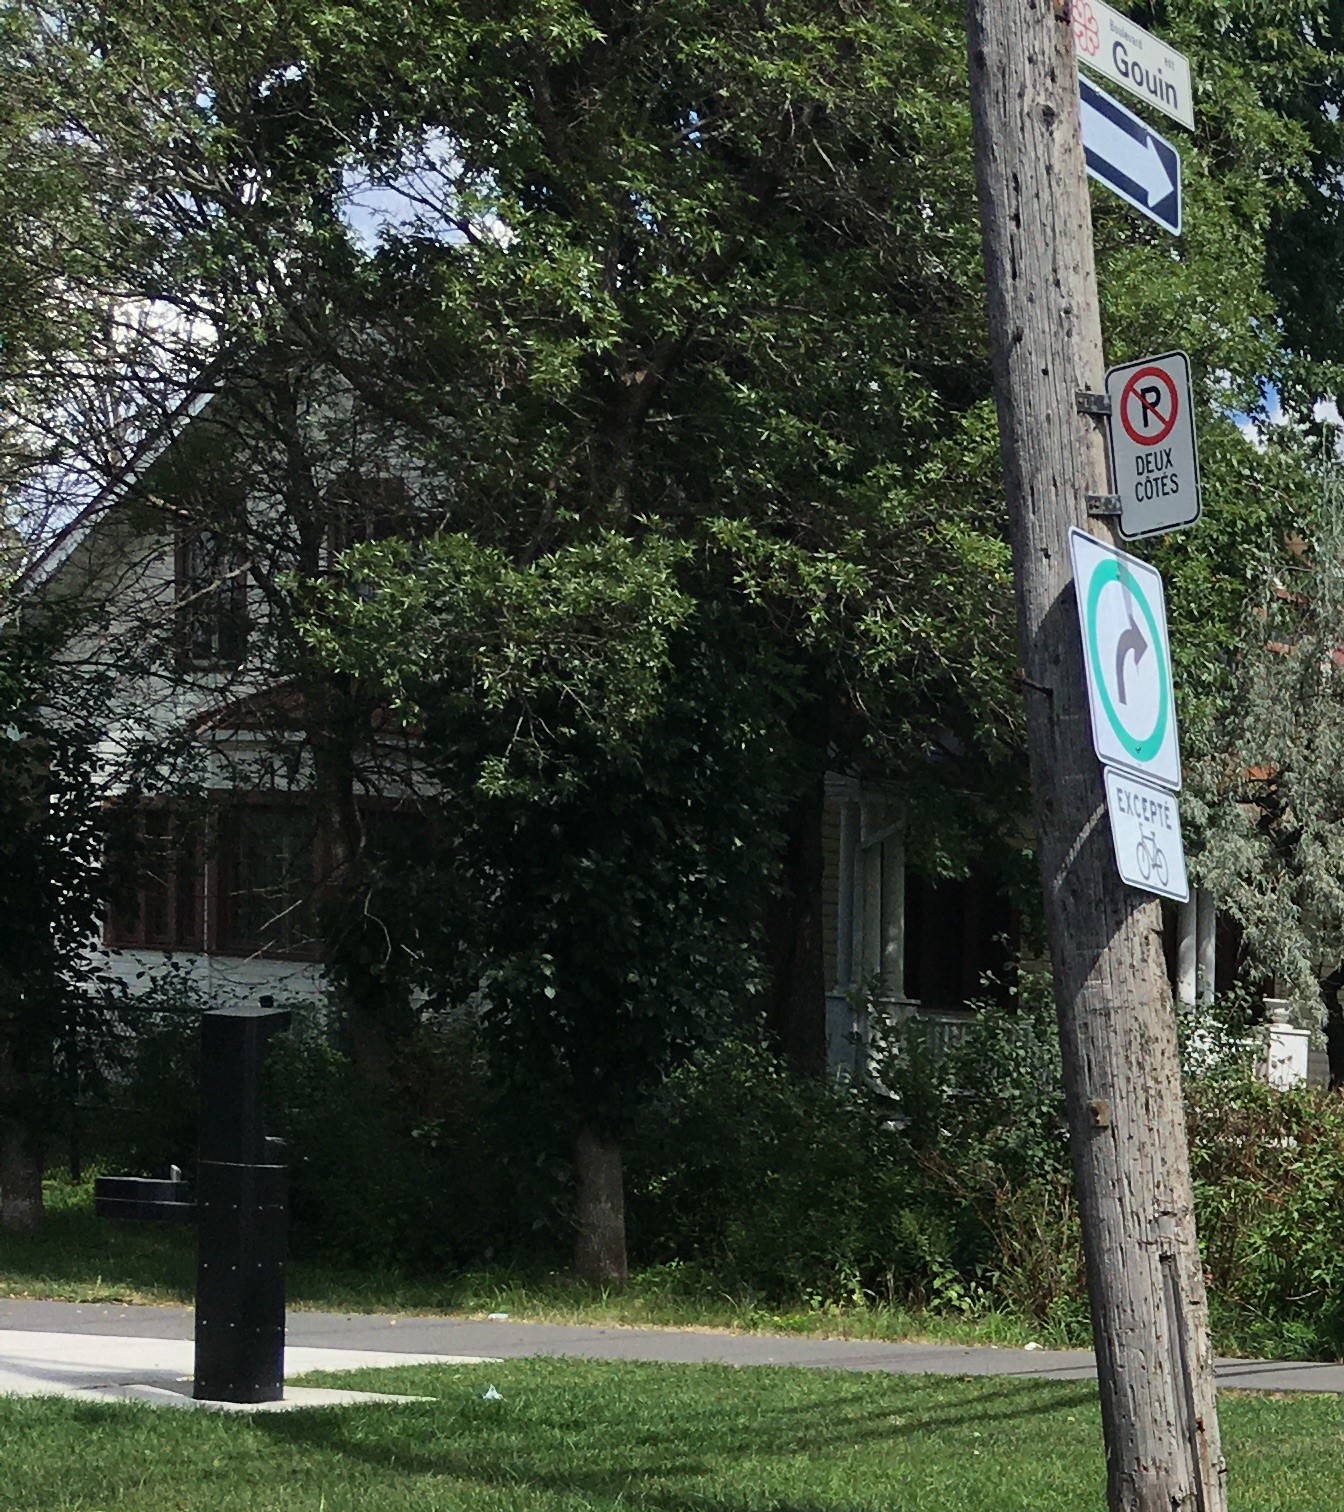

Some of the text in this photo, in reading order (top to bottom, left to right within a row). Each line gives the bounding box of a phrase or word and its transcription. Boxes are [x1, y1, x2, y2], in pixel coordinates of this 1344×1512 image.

[1112, 40, 1179, 110] Gouin
[1135, 447, 1174, 476] DEUX
[1134, 472, 1180, 503] CÔTÉS
[1116, 786, 1173, 831] EXCEPTÉ
